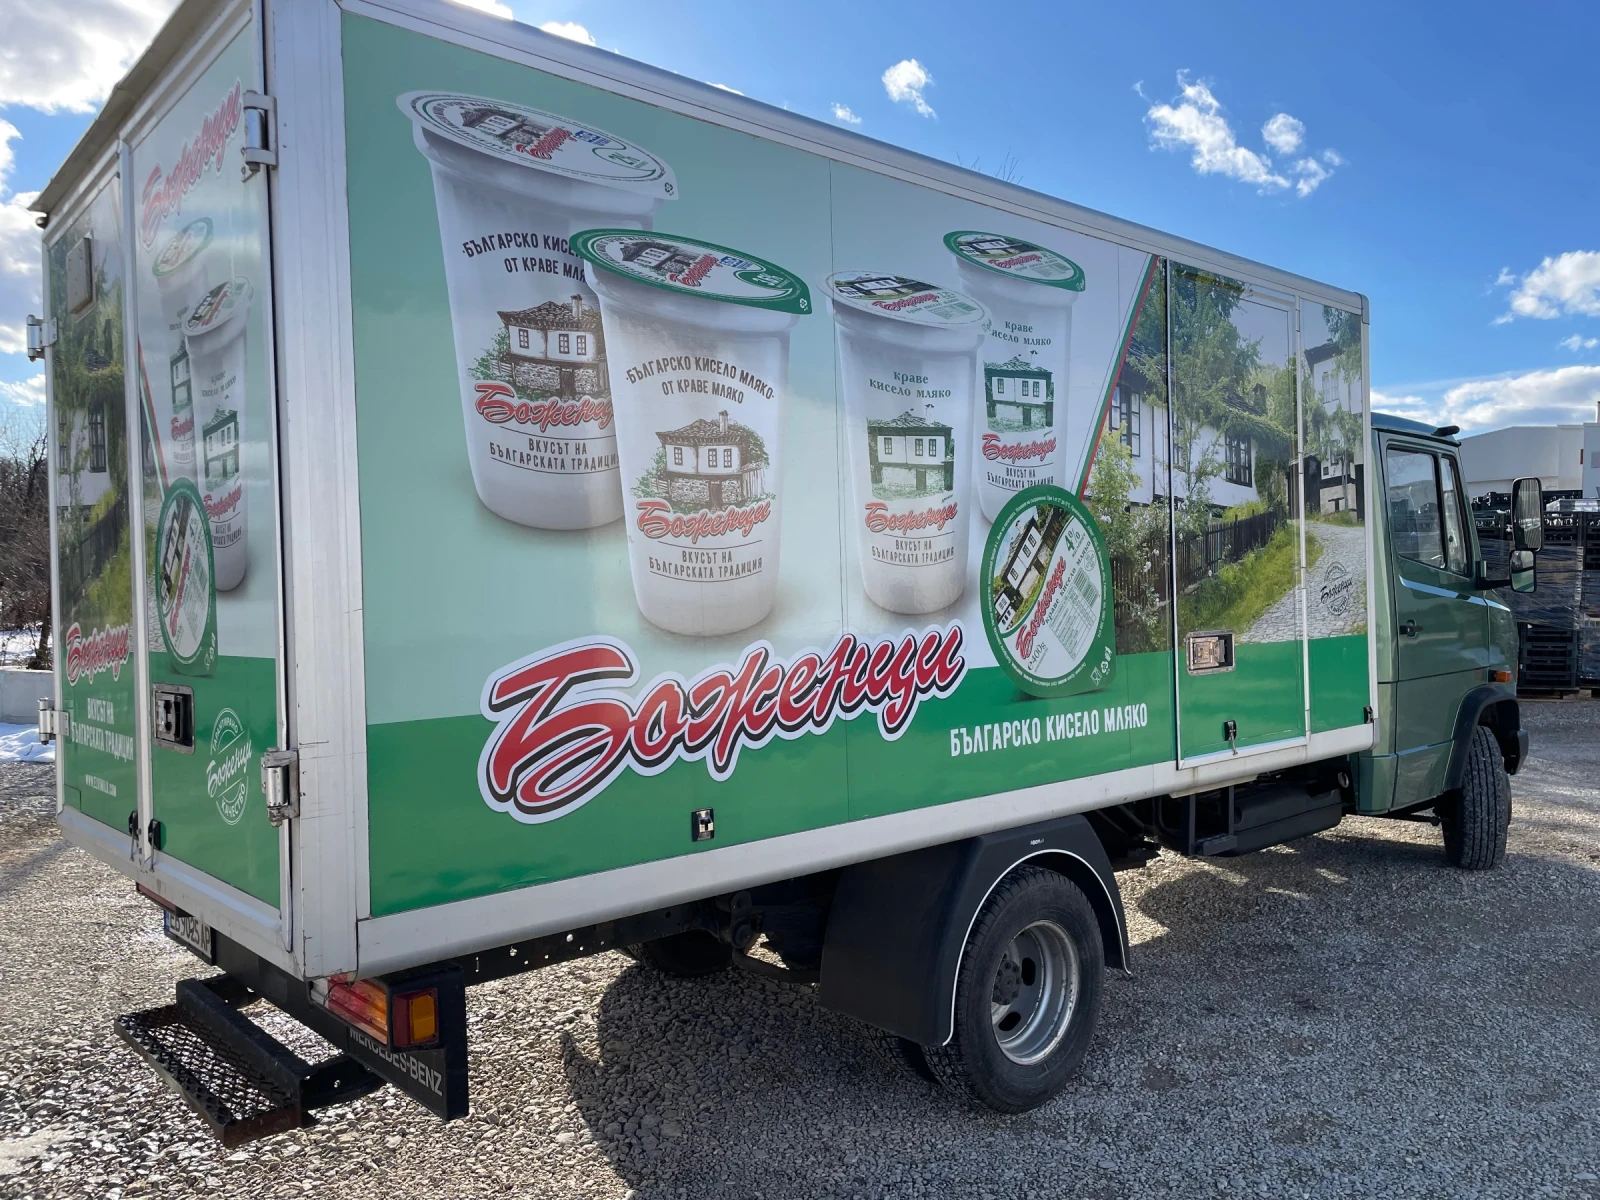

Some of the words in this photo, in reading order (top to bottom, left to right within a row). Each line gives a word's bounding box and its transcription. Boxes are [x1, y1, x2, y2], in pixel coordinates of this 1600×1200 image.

[504, 257, 518, 273] ОТ
[523, 257, 559, 274] КРАВЕ
[563, 262, 586, 283] МЛЯ
[991, 330, 1019, 343] исело
[1023, 337, 1051, 346] мляко
[1004, 320, 1033, 334] краве
[694, 356, 737, 380] КИСЕЛО
[739, 368, 773, 400] МЛЯКО
[869, 378, 911, 397] кисело
[916, 389, 951, 399] мляко
[893, 371, 929, 385] краве
[661, 381, 676, 396] ОТ
[677, 379, 709, 394] КРАВЕ
[712, 381, 744, 404] МЛЯКО
[474, 383, 613, 432] Боженц
[489, 442, 566, 470] БЪЛГАРСКАТА
[528, 437, 570, 455] ВКУСЪТ
[575, 441, 588, 455] НА
[636, 501, 771, 544] Боженци
[865, 502, 958, 535] Боженци
[682, 551, 717, 563] ВКУСЪТ
[722, 551, 732, 562] НА
[872, 545, 918, 563] БЪЛГАРСКАТА
[922, 546, 955, 563] ТРАДИЦИЯ
[895, 539, 921, 551] ВКУСЪТ
[924, 540, 932, 550] НА
[649, 556, 714, 579] БЪЛГАРСКАТА
[719, 557, 763, 579] ТРАДИЦИЯ
[486, 624, 966, 816] Боженци
[950, 717, 1041, 757] БЪЛГАРСКО
[1046, 709, 1099, 742] КИСЕЛО
[1104, 703, 1148, 733] МЛЯКО
[206, 739, 252, 798] Боженци
[221, 783, 246, 818] КАЧЕСТВО
